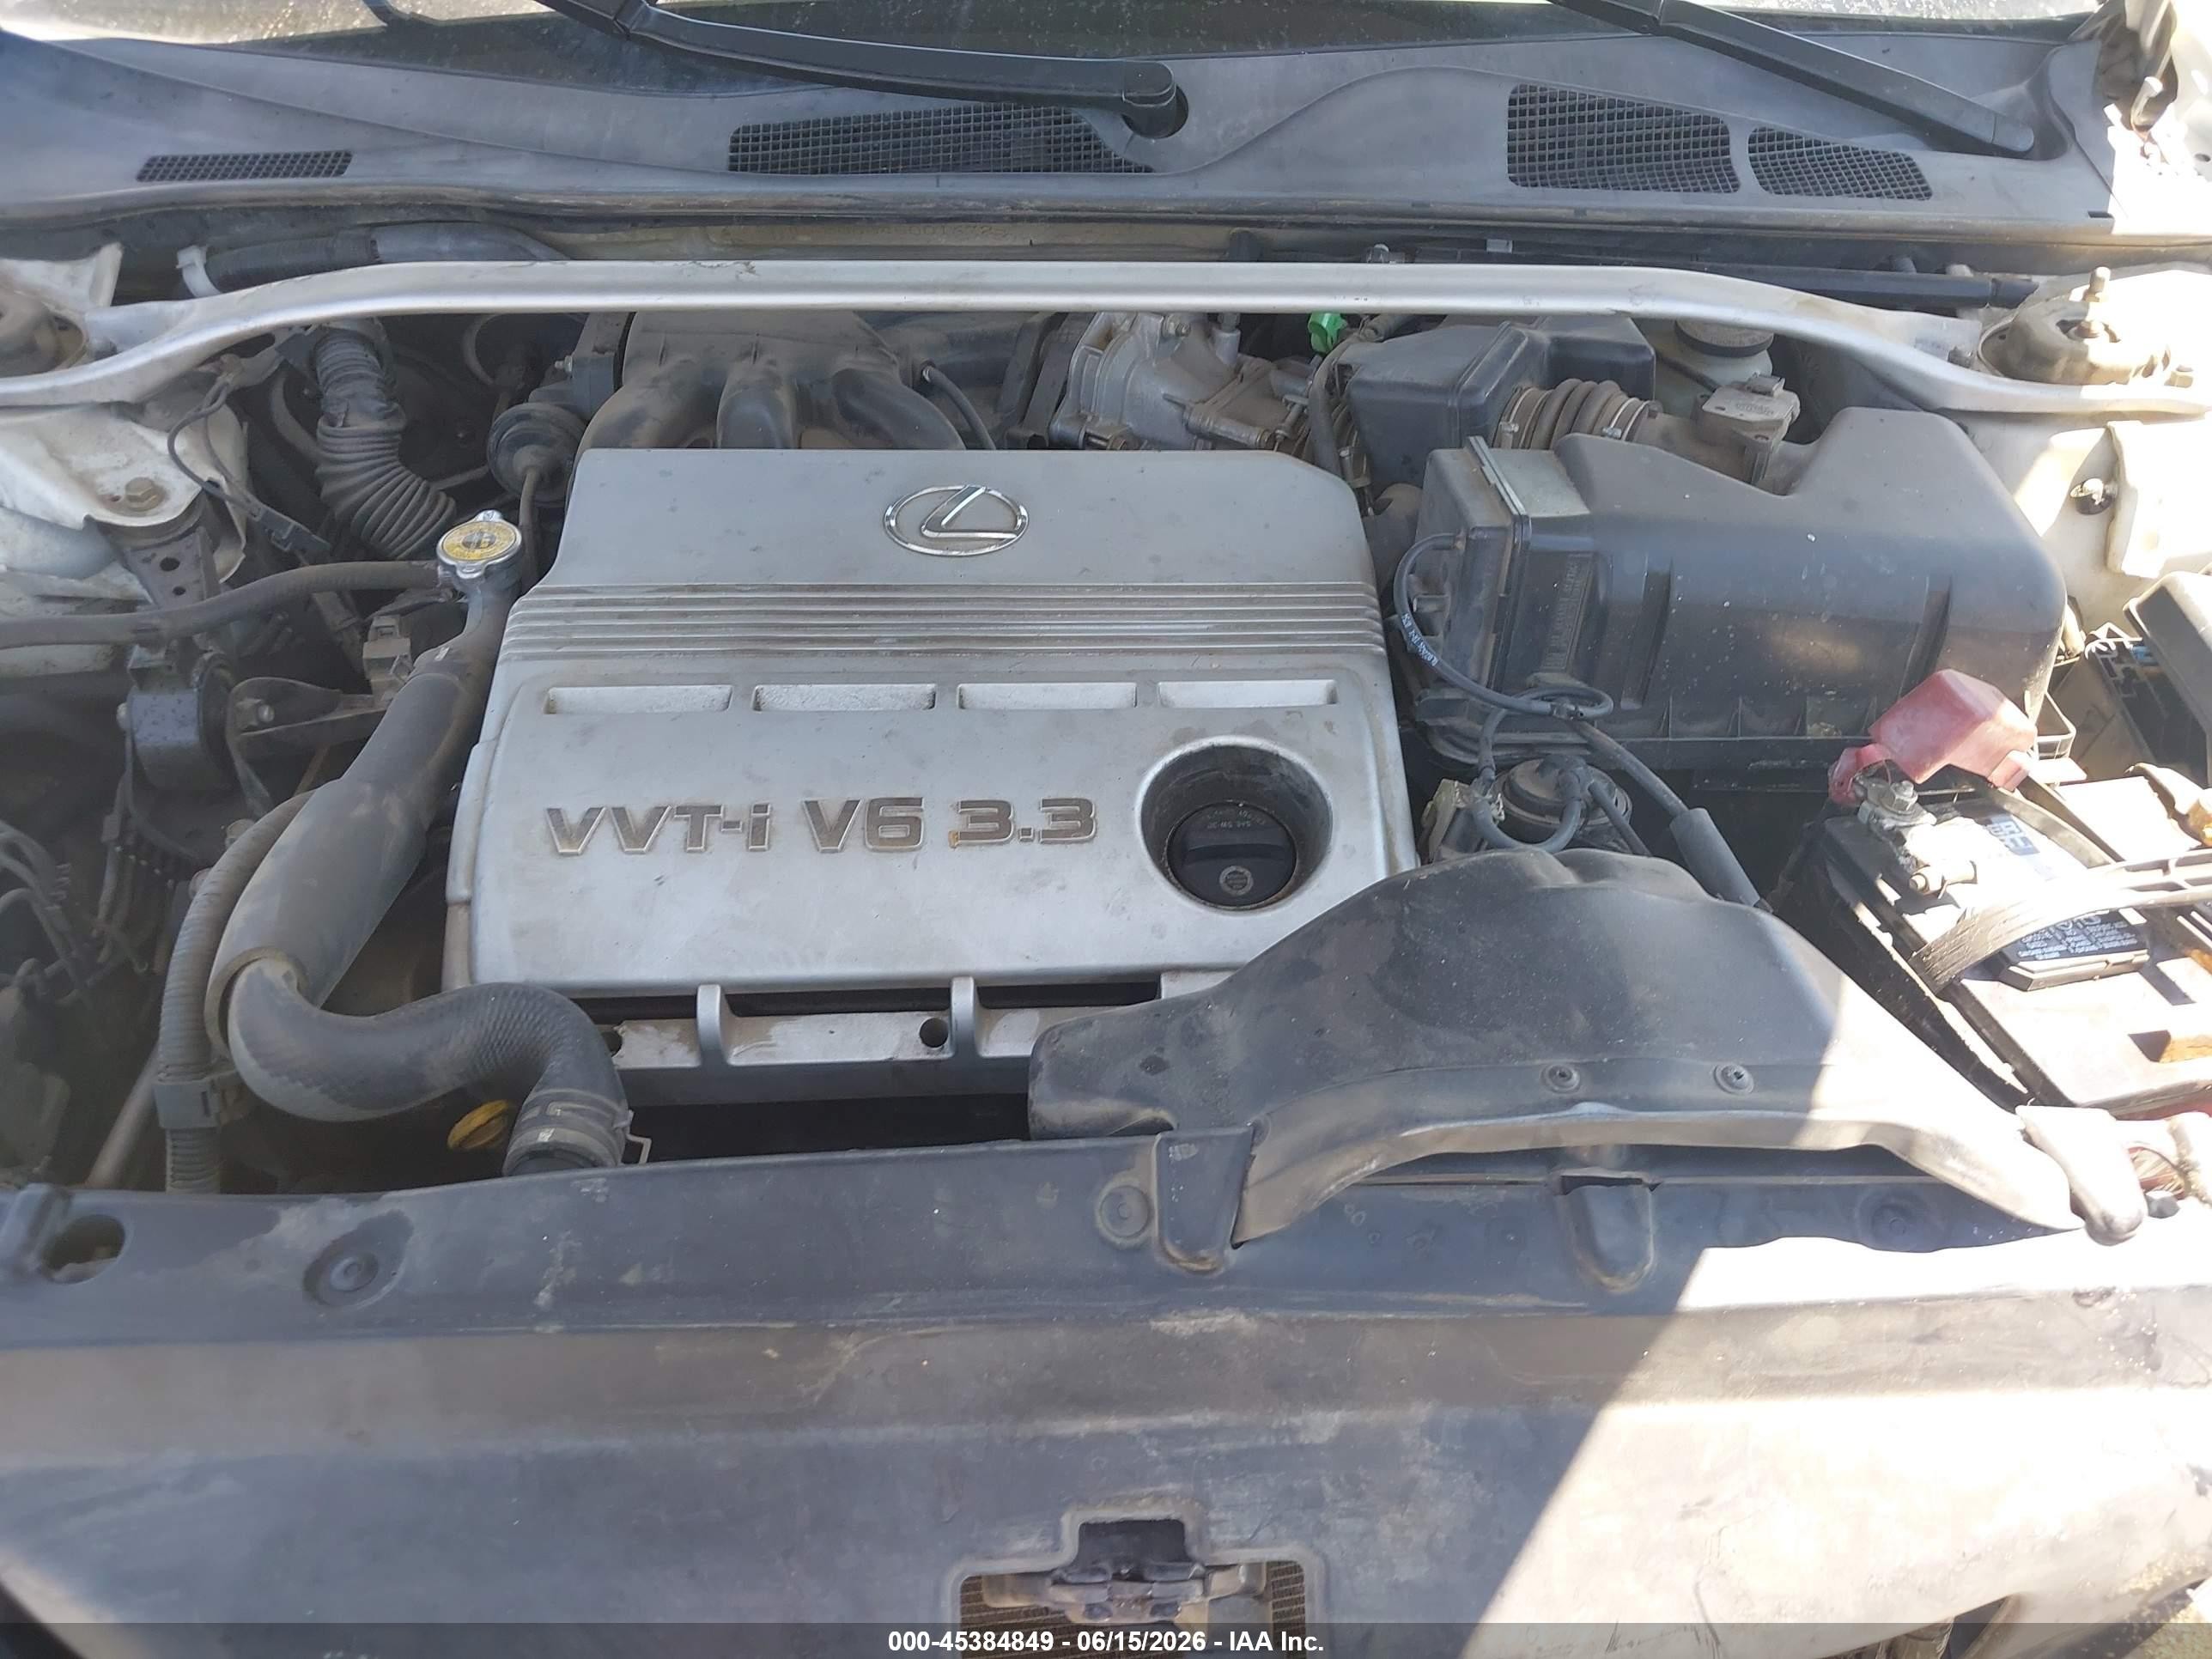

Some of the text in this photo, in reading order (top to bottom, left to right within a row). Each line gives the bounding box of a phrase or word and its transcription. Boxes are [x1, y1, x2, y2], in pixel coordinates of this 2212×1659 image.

[546, 797, 1097, 855] VVT-i V6 3.3
